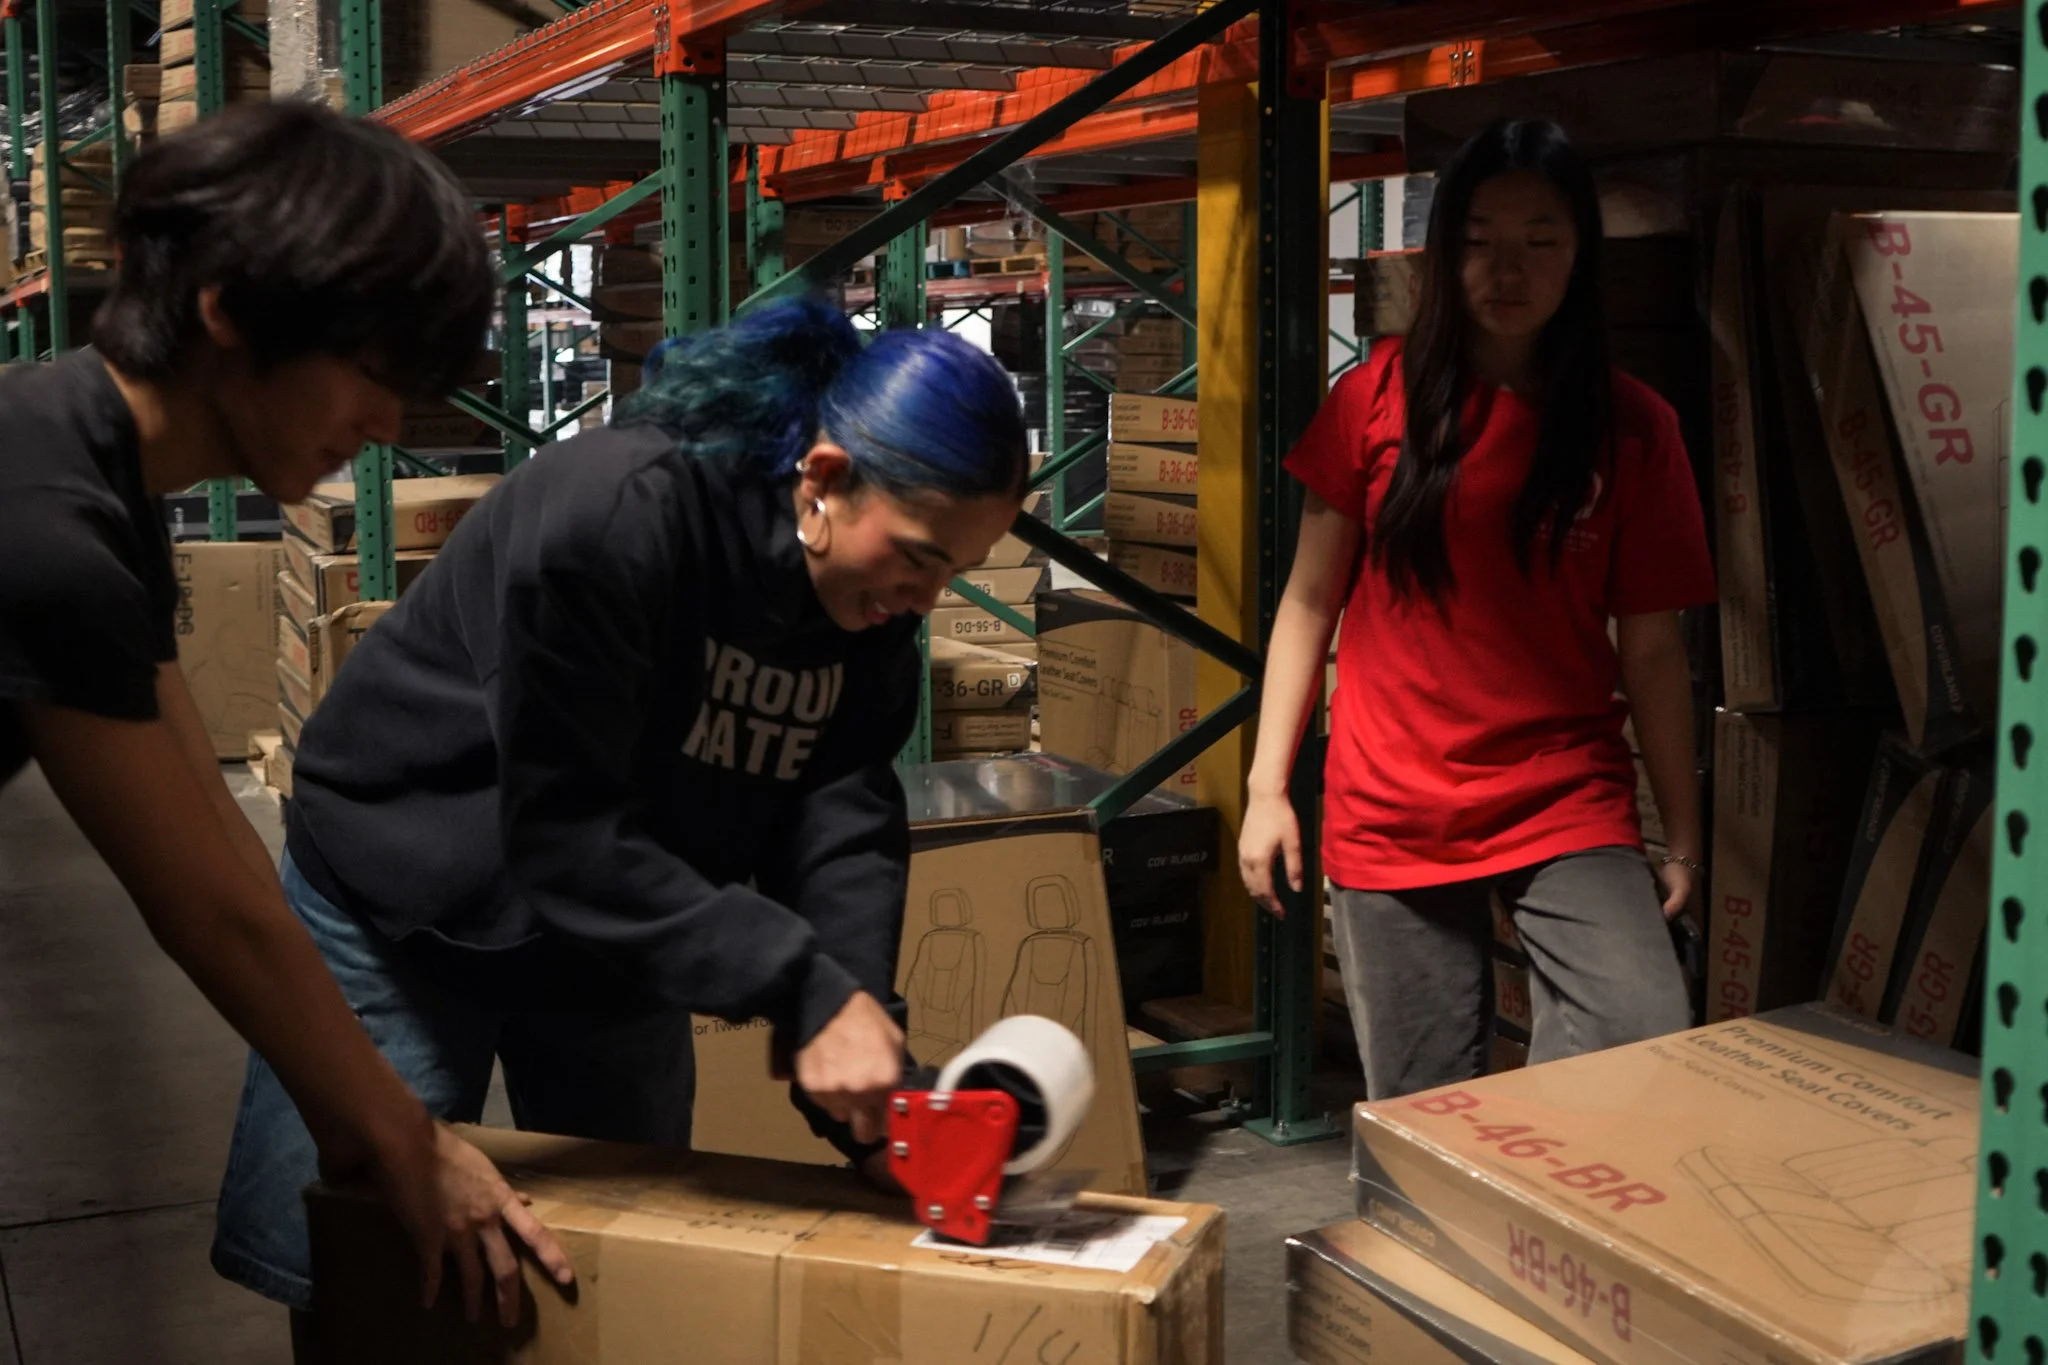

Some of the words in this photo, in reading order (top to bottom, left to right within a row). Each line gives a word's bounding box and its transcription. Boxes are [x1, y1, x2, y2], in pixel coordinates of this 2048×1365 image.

[1867, 222, 1974, 467] B-45-GR
[1162, 408, 1197, 430] B-36-G
[1716, 381, 1748, 515] B-45-GR
[414, 509, 464, 534] 9-RD
[1838, 407, 1900, 550] B-45-GR
[955, 621, 1001, 634] B-56-DG
[937, 679, 1003, 698] -36-GR
[1839, 932, 1880, 1015] 5-GR
[695, 1024, 709, 1035] or
[1720, 1025, 1833, 1074] Premium
[1836, 1071, 1954, 1121] Comfort
[1687, 1033, 1773, 1071] Leather
[1770, 1068, 1831, 1095] Seat
[1826, 1091, 1918, 1131] Covers
[1409, 1090, 1667, 1213] B-46-BR
[1507, 1220, 1632, 1343] B-46-BR
